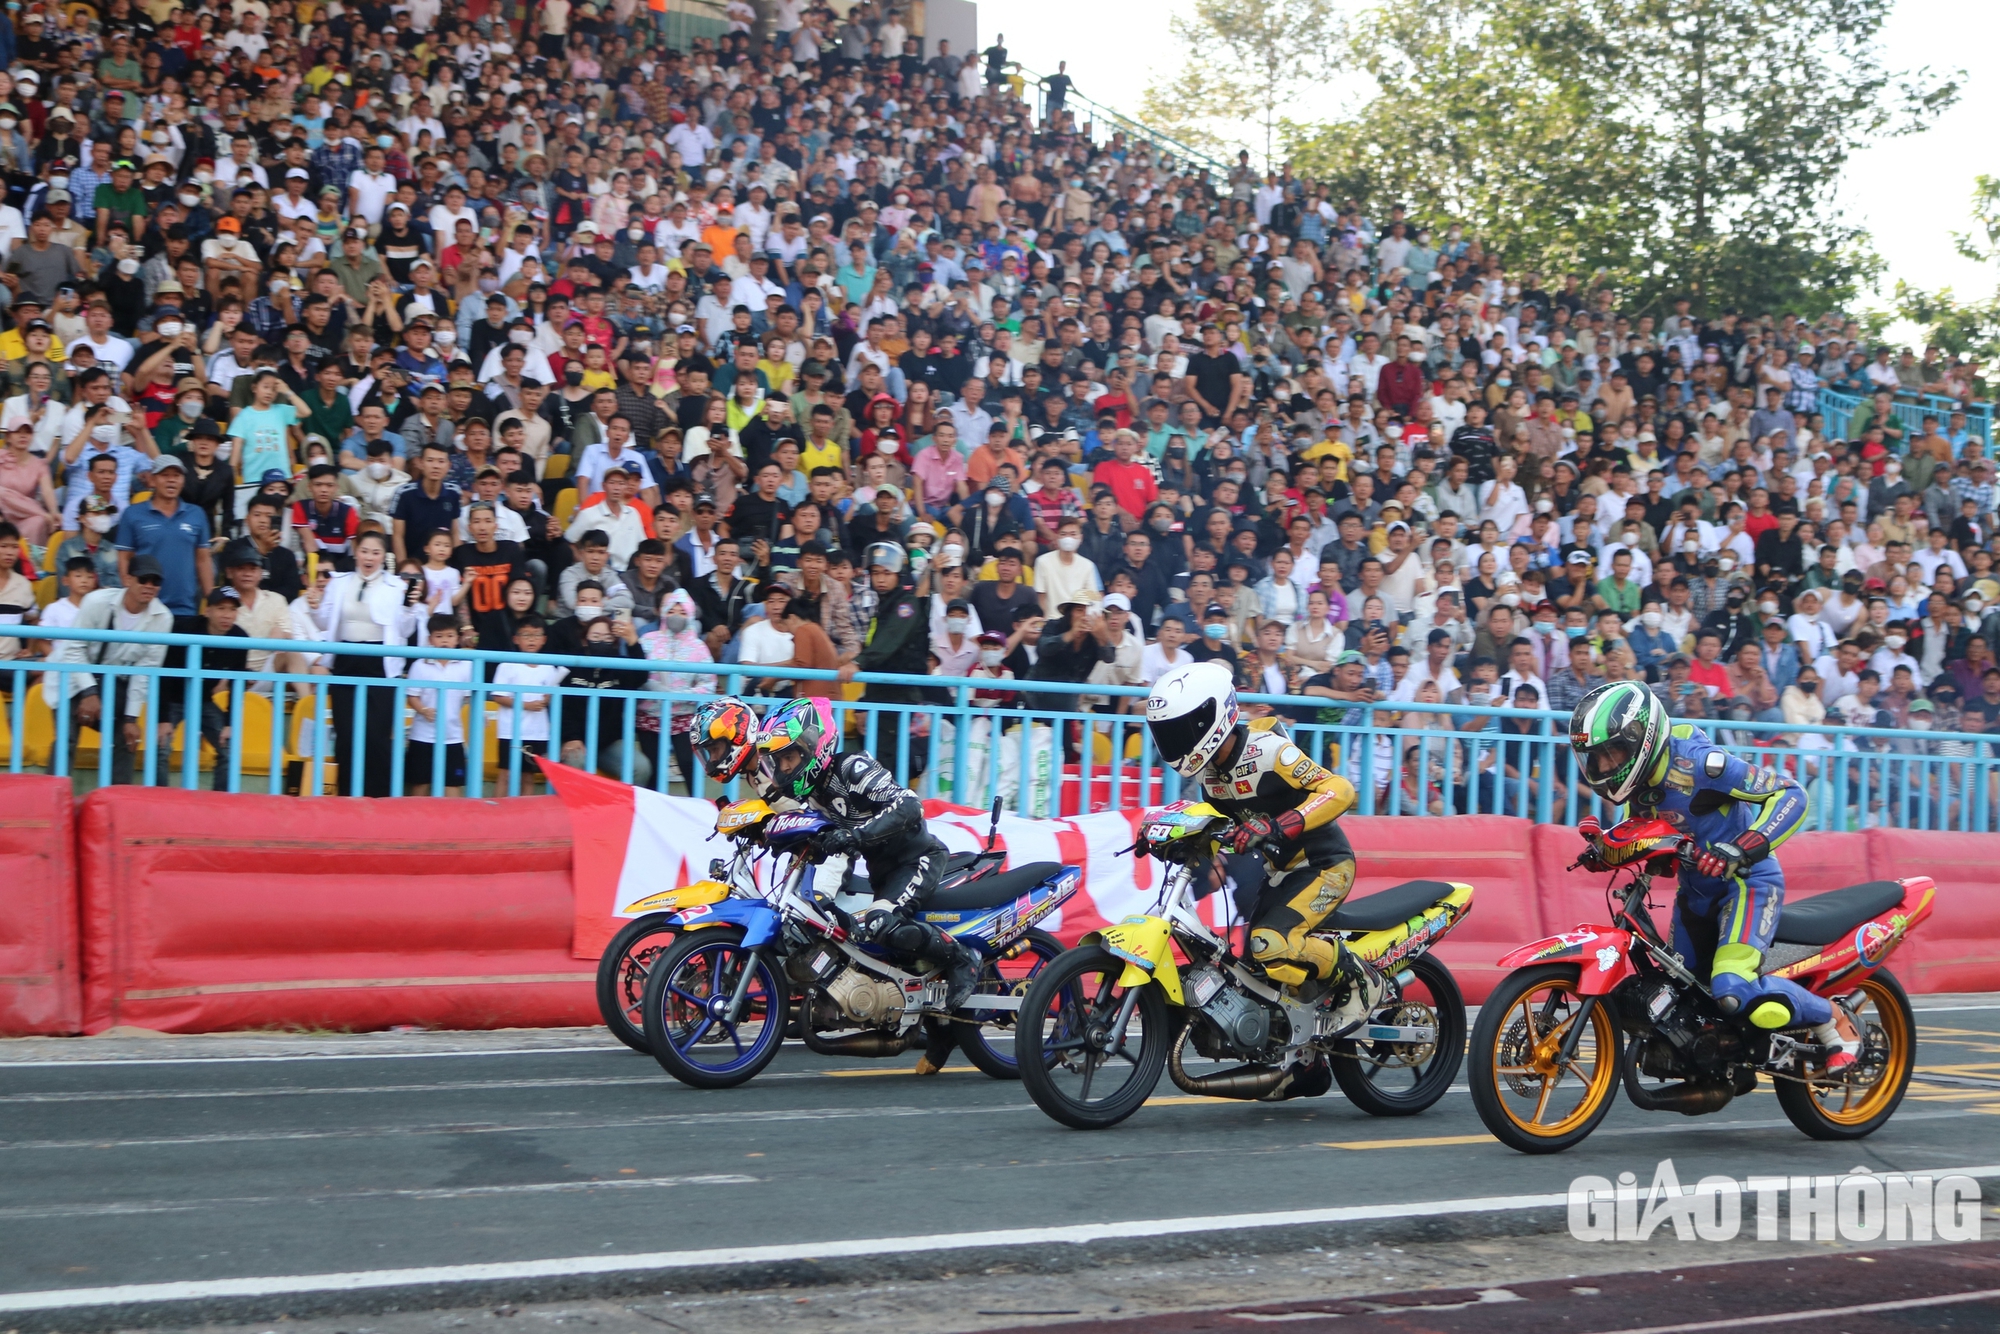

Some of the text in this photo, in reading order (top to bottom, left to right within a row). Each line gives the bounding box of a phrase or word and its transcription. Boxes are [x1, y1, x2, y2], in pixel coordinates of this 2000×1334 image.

[1202, 716, 1228, 754] KYT
[811, 745, 831, 778] NHK
[1236, 764, 1249, 777] elf
[1301, 767, 1321, 786] MOTUL
[1212, 786, 1226, 795] RK
